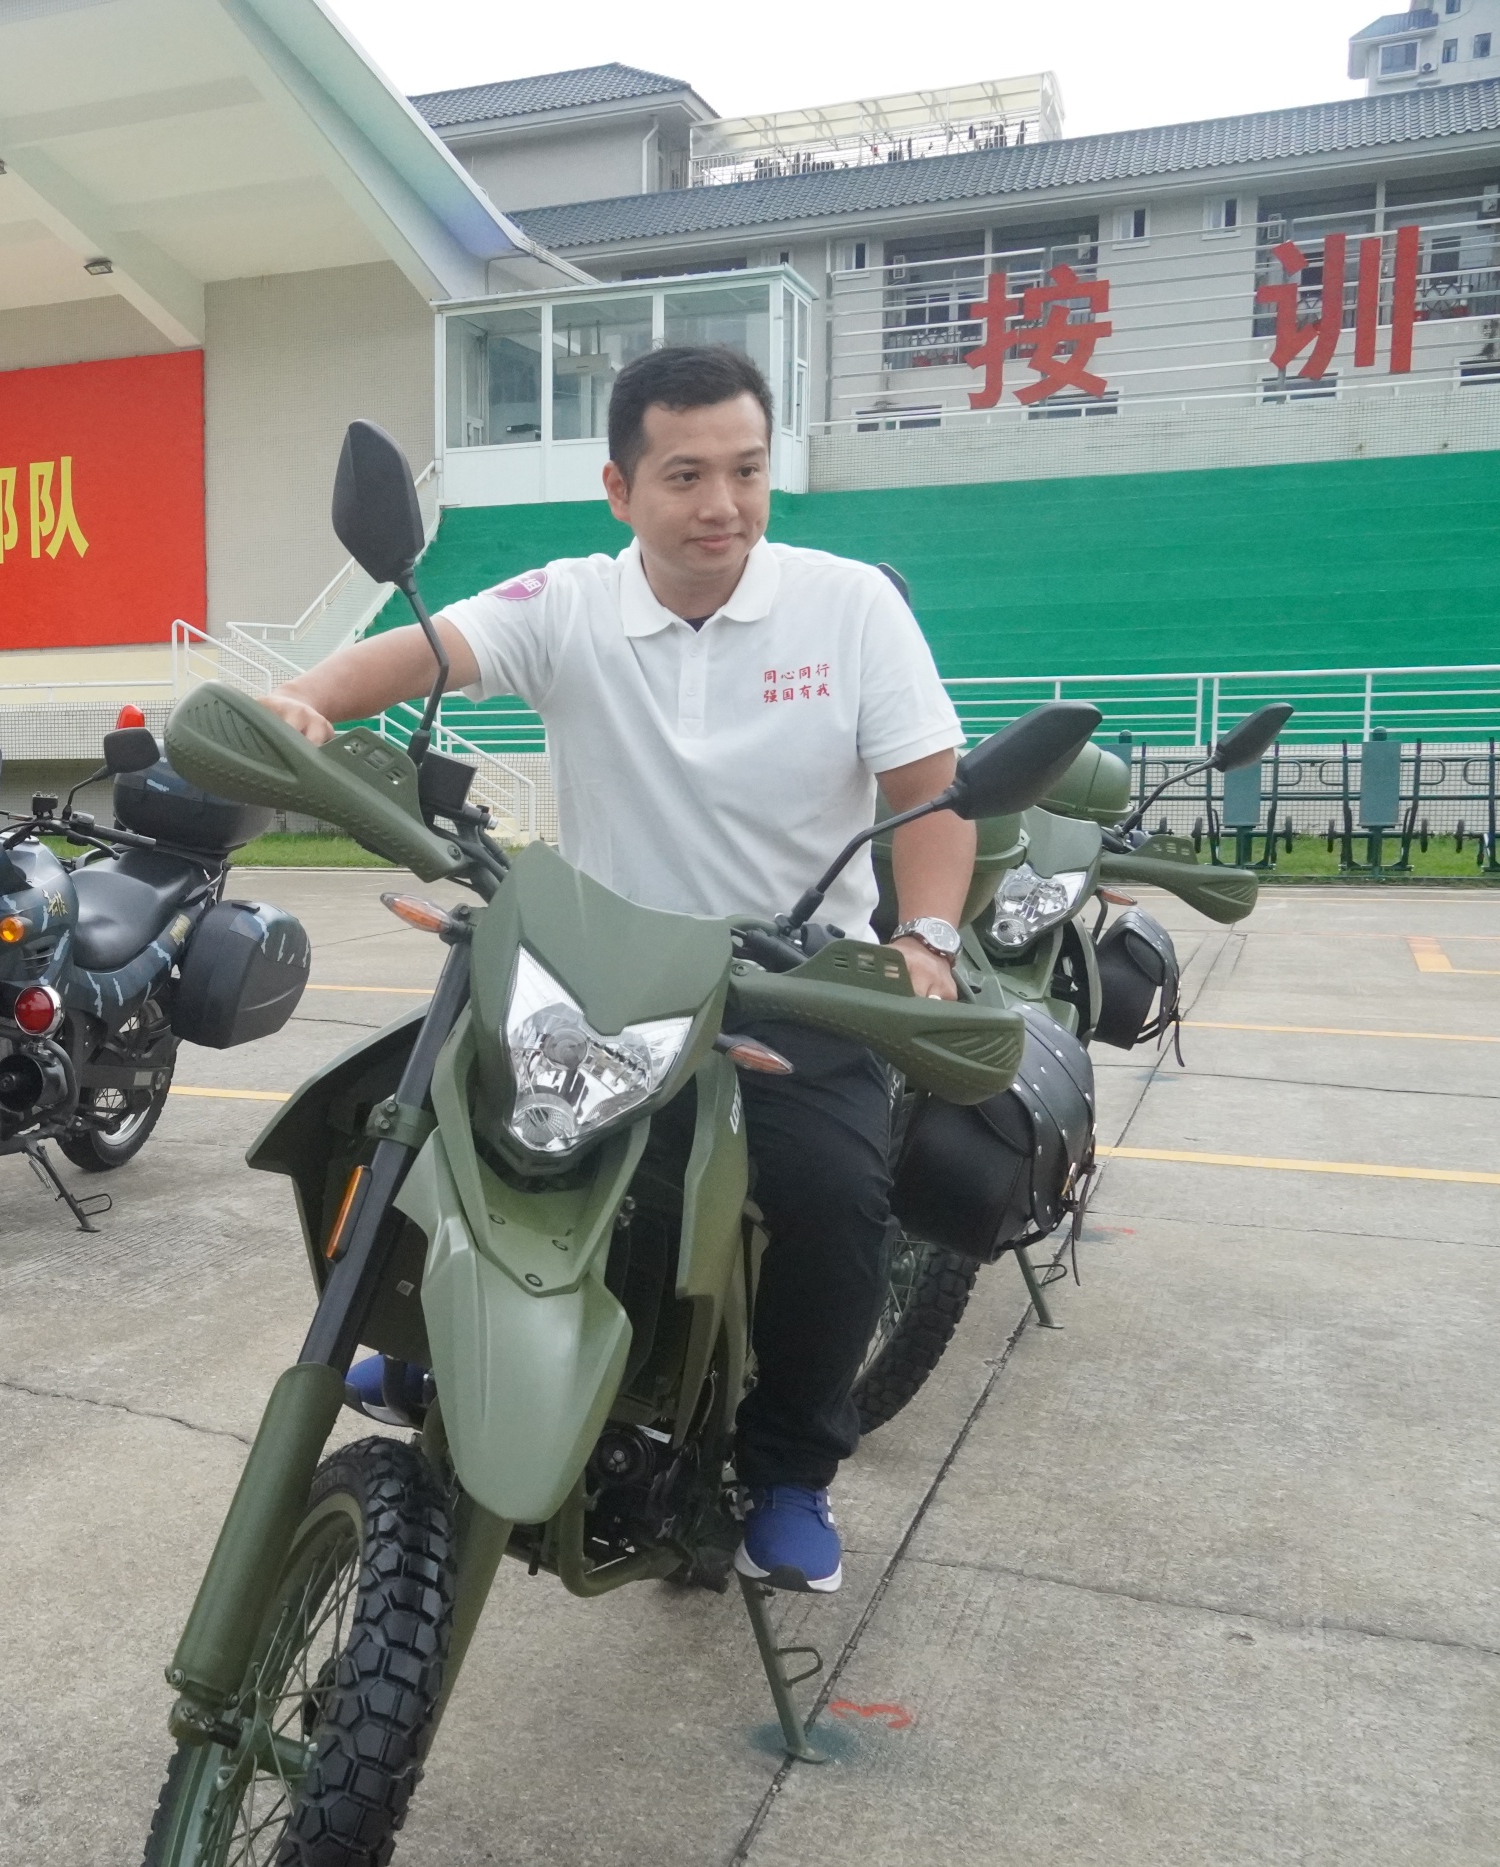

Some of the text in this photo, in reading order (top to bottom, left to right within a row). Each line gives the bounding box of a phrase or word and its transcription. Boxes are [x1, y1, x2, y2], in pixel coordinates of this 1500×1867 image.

[965, 225, 1421, 410] 按 训
[763, 663, 831, 684] 同心同行
[763, 683, 831, 704] 强国有我
